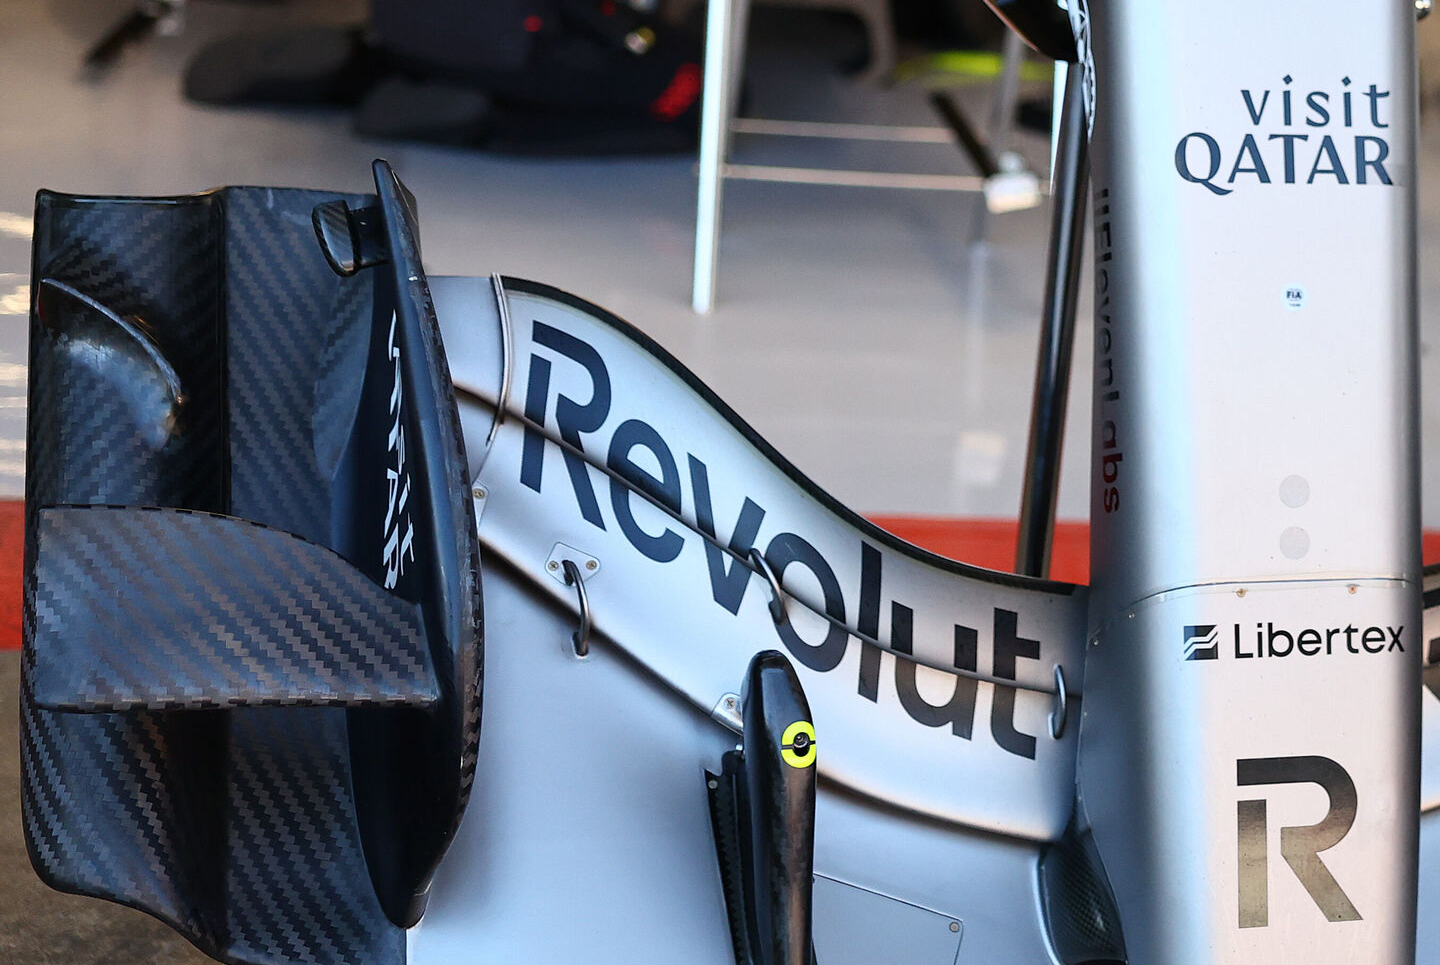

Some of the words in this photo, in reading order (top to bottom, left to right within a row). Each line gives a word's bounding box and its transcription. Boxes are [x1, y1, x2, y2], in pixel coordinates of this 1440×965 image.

[1240, 74, 1391, 129] visit
[1173, 131, 1395, 197] QATAR
[519, 319, 1041, 761] Revolut
[1233, 622, 1406, 660] Libertex
[1236, 755, 1364, 929] R
